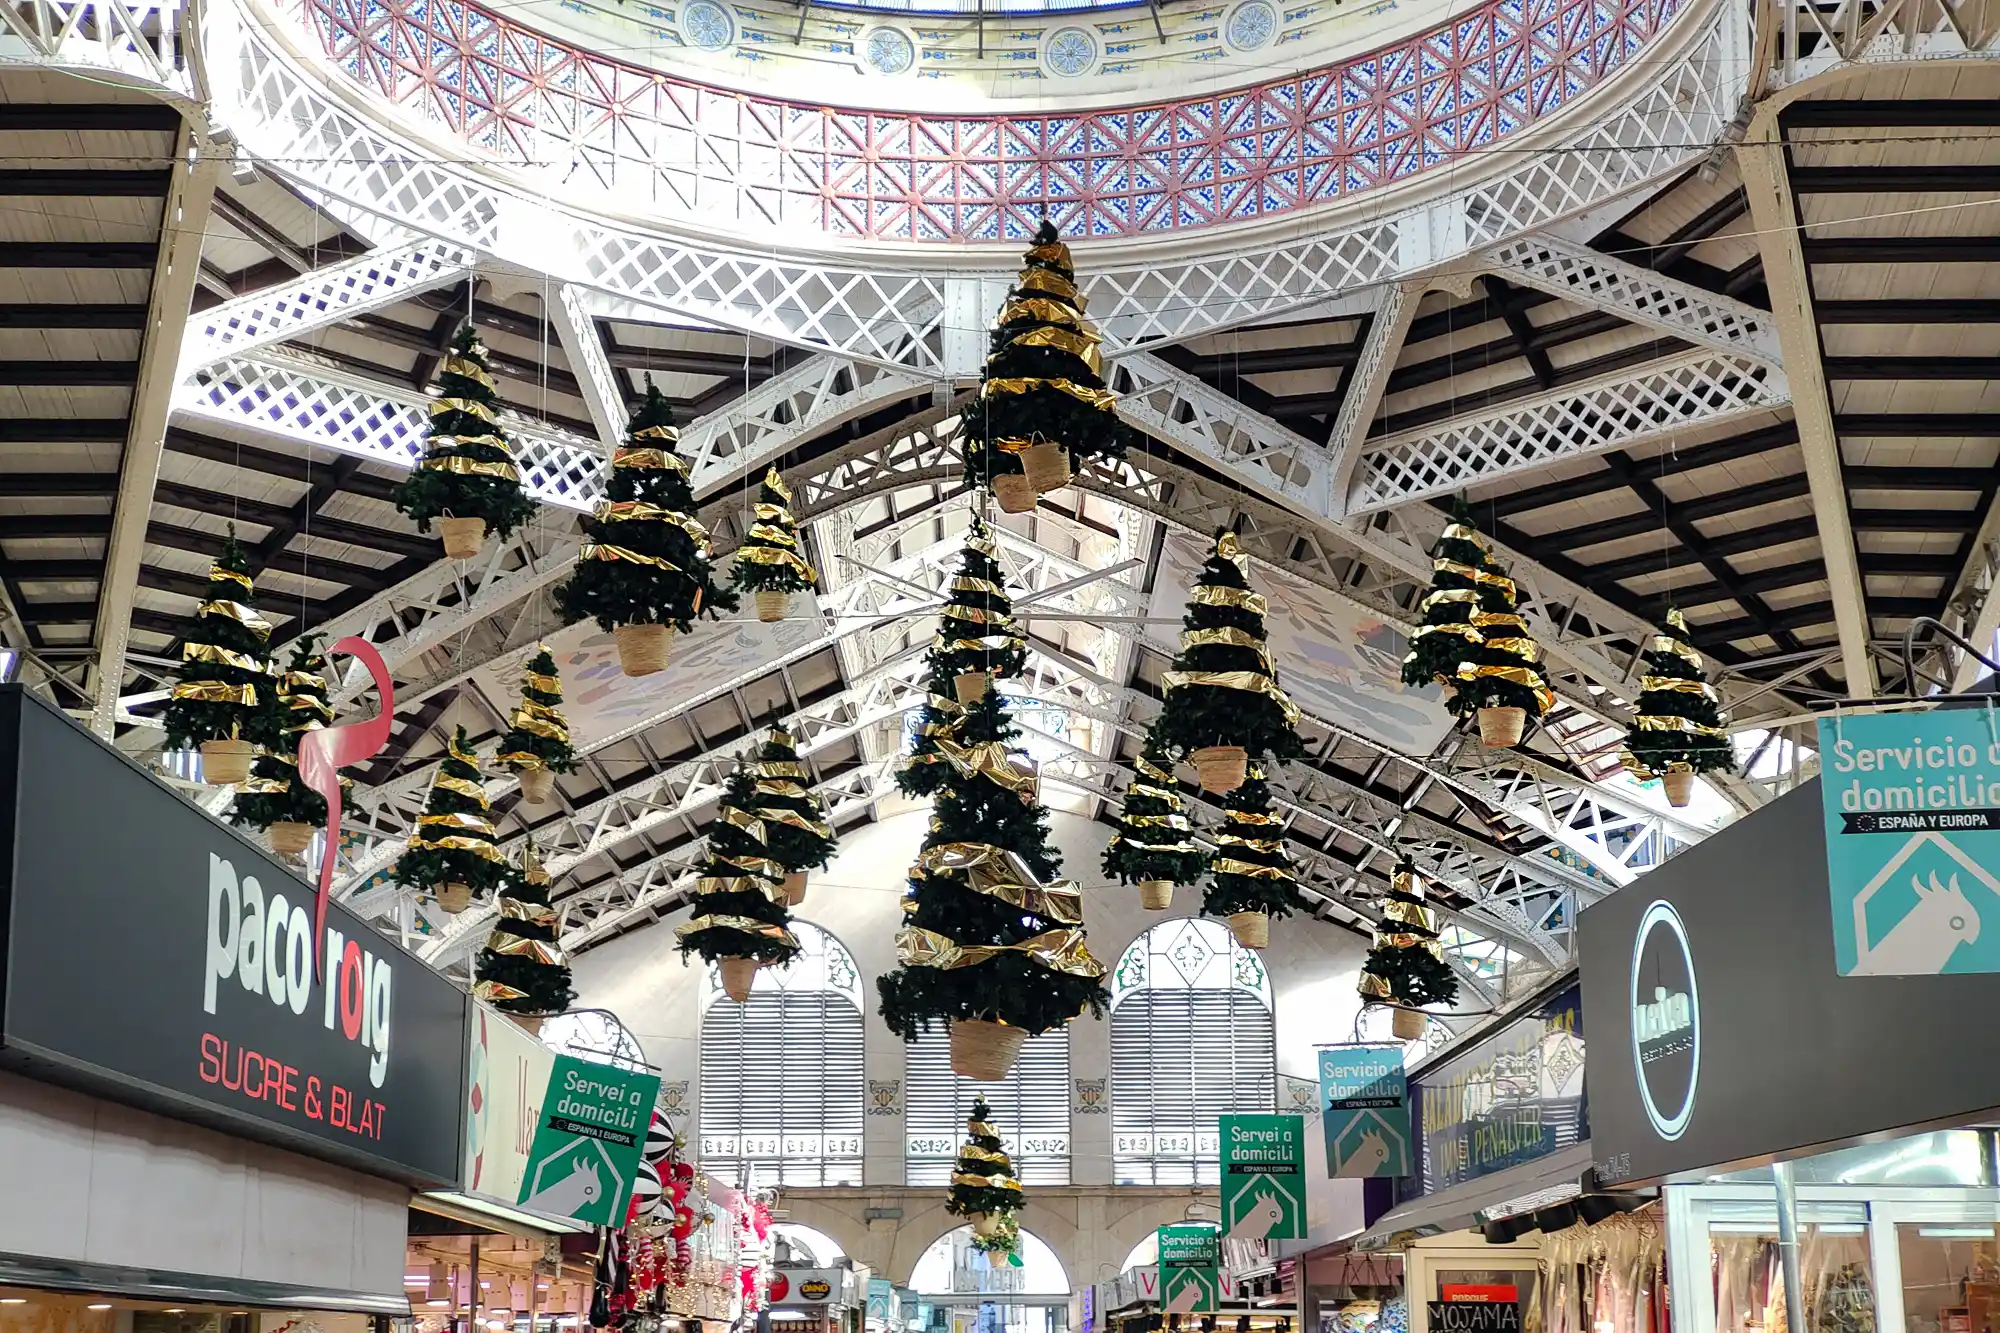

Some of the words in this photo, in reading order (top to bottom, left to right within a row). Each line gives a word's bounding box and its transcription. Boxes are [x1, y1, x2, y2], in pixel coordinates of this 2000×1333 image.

[1834, 735, 1977, 772] Servicio
[1841, 774, 2000, 811] domicilio
[1879, 813, 1927, 829] ESPAÑA
[1927, 815, 1937, 828] Y
[1939, 813, 1989, 828] EUROPA
[203, 851, 312, 1015] paco
[324, 926, 392, 1089] roig
[1323, 1060, 1388, 1079] Servicio
[1391, 1064, 1401, 1076] a
[200, 1033, 299, 1111] SUCRE
[304, 1075, 324, 1121] &
[330, 1085, 387, 1141] BLAT
[563, 1070, 627, 1102] Servei
[629, 1090, 643, 1106] a
[1328, 1079, 1401, 1098] domicilio
[556, 1094, 638, 1129] domicili
[567, 1122, 598, 1137] ESPANYA
[603, 1131, 631, 1144] EUROPA
[1231, 1126, 1279, 1142] Servei
[1283, 1131, 1292, 1142] a
[1231, 1145, 1293, 1161] domicili
[1161, 1234, 1204, 1246] Servicio
[1207, 1237, 1214, 1245] a
[1163, 1247, 1213, 1259] domicilio
[1427, 1303, 1518, 1330] MOJAMA
